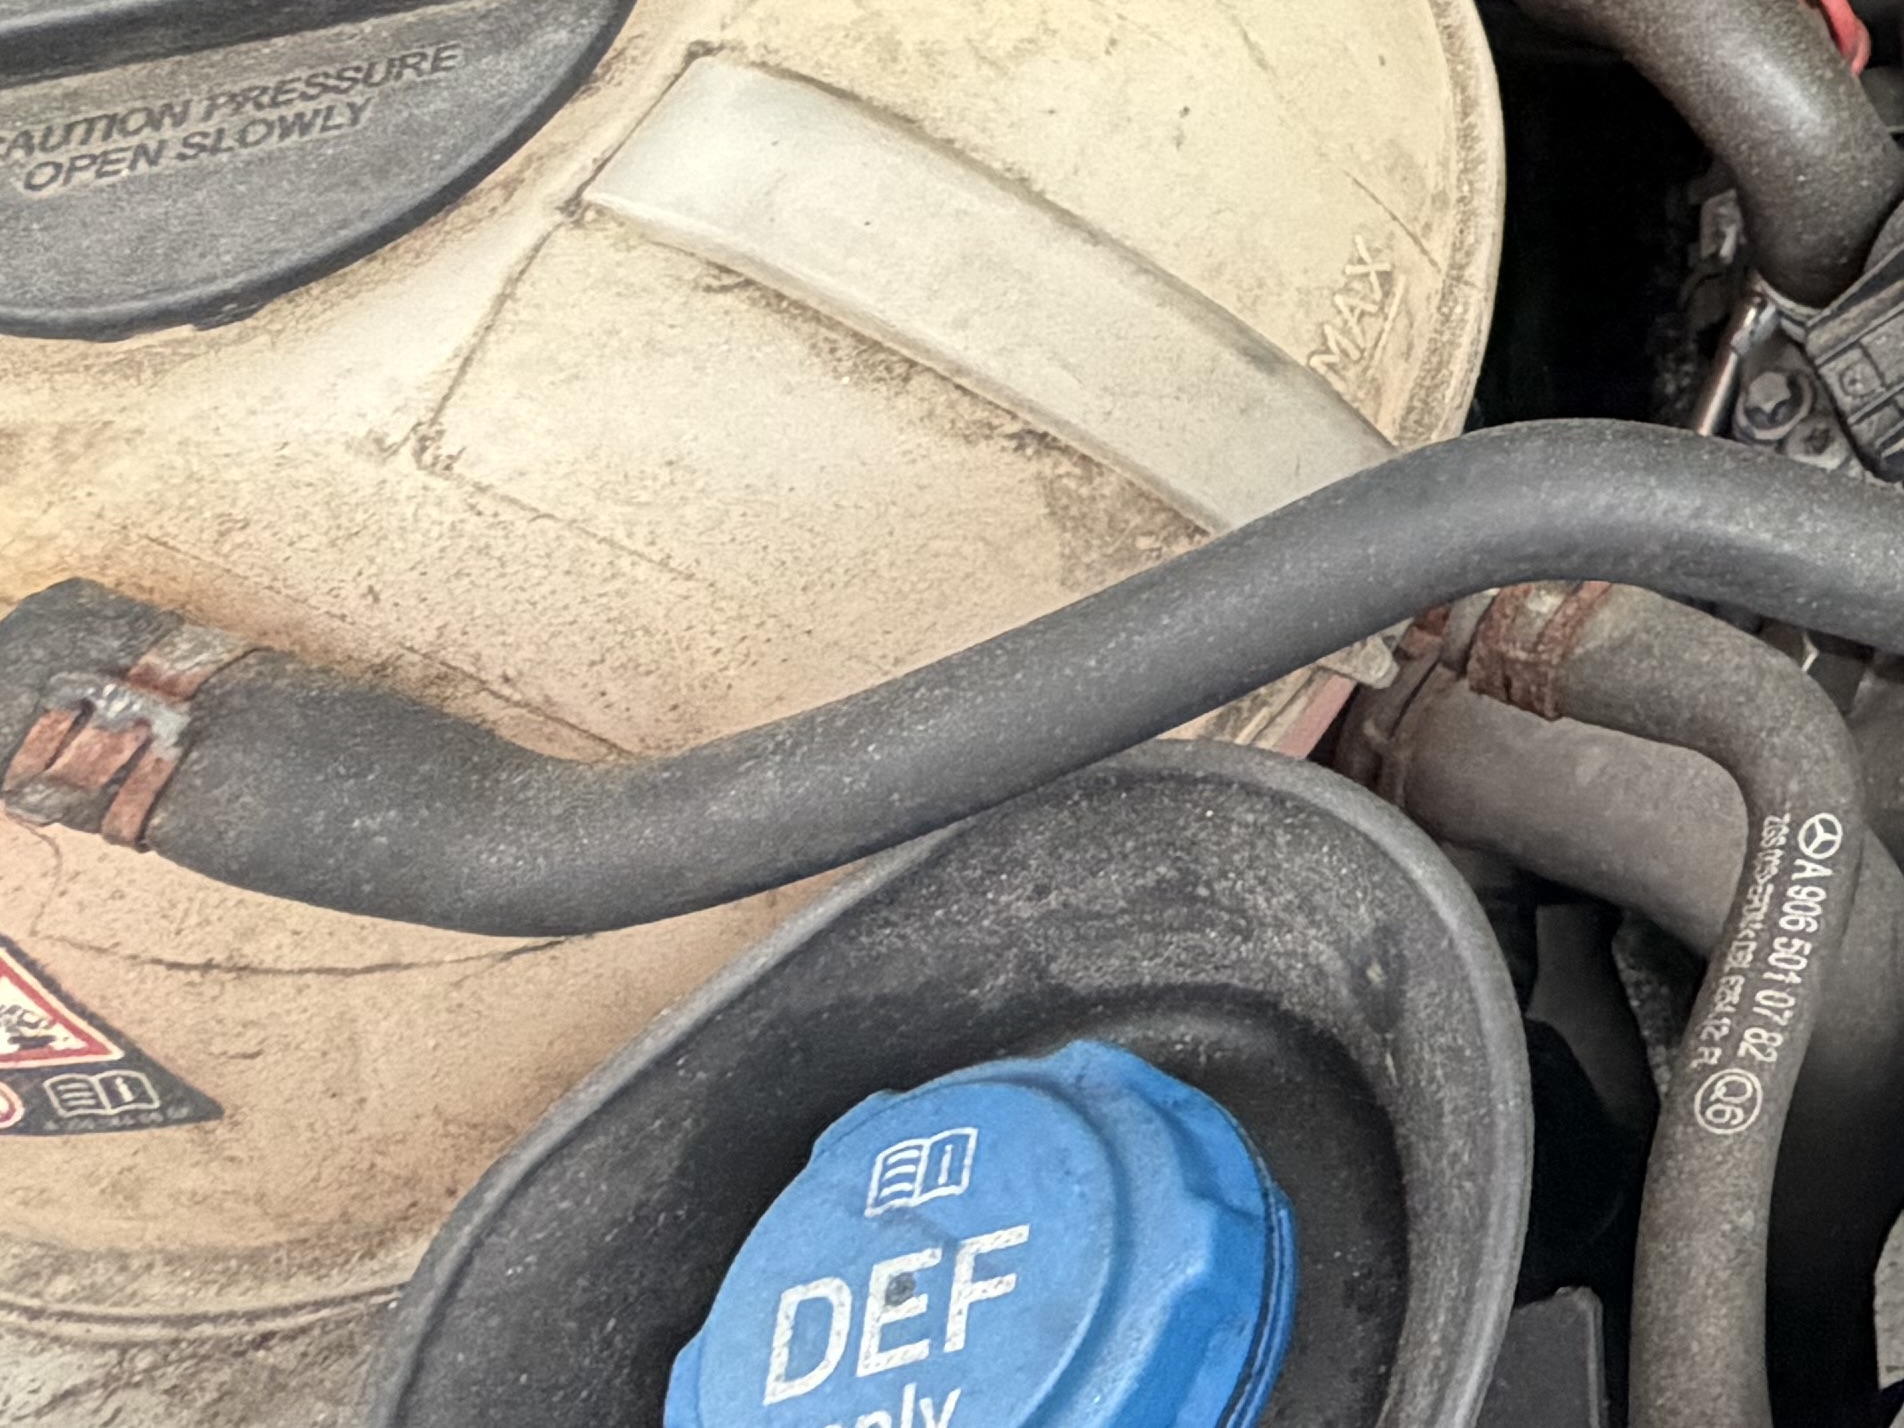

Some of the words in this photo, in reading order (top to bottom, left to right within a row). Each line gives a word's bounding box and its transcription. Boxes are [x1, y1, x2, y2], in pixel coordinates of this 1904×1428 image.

[0, 97, 191, 160] AUTION
[201, 43, 462, 123] PRESSURE
[23, 140, 164, 192] OPEN
[176, 96, 373, 161] SLOWLY
[1309, 235, 1392, 393] MAX
[1791, 858, 1833, 880] A
[1778, 884, 1827, 933] 906
[1762, 936, 1812, 984] 501
[1753, 989, 1796, 1026] 07
[1737, 1027, 1784, 1062] 82
[1704, 1074, 1753, 1125] Q6
[762, 1223, 1030, 1407] DEF
